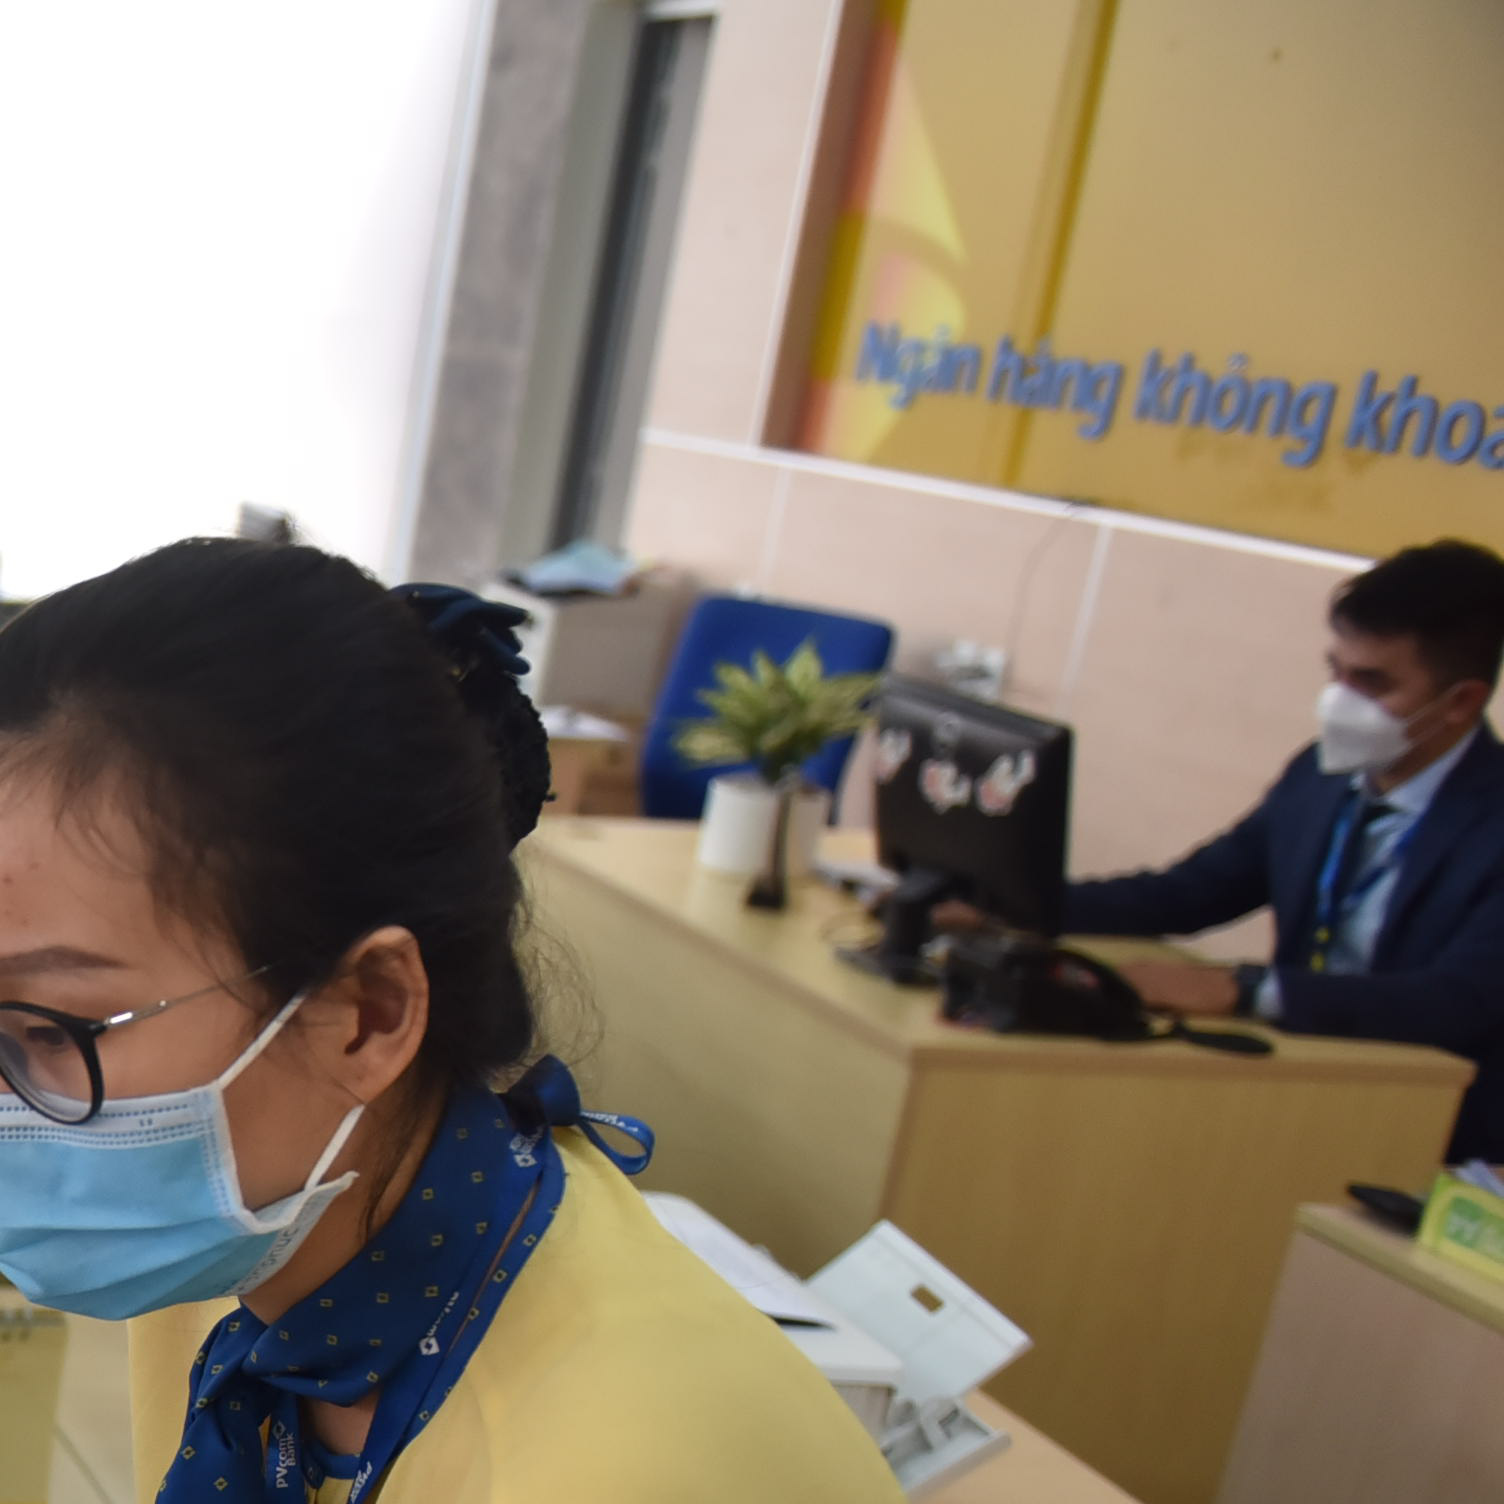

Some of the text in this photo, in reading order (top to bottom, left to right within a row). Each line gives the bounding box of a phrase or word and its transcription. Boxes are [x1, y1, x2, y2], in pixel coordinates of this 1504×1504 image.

[987, 336, 1124, 440] hàng
[1133, 348, 1337, 467] không
[276, 1438, 288, 1488] PVcom
[287, 1433, 296, 1466] Bank
